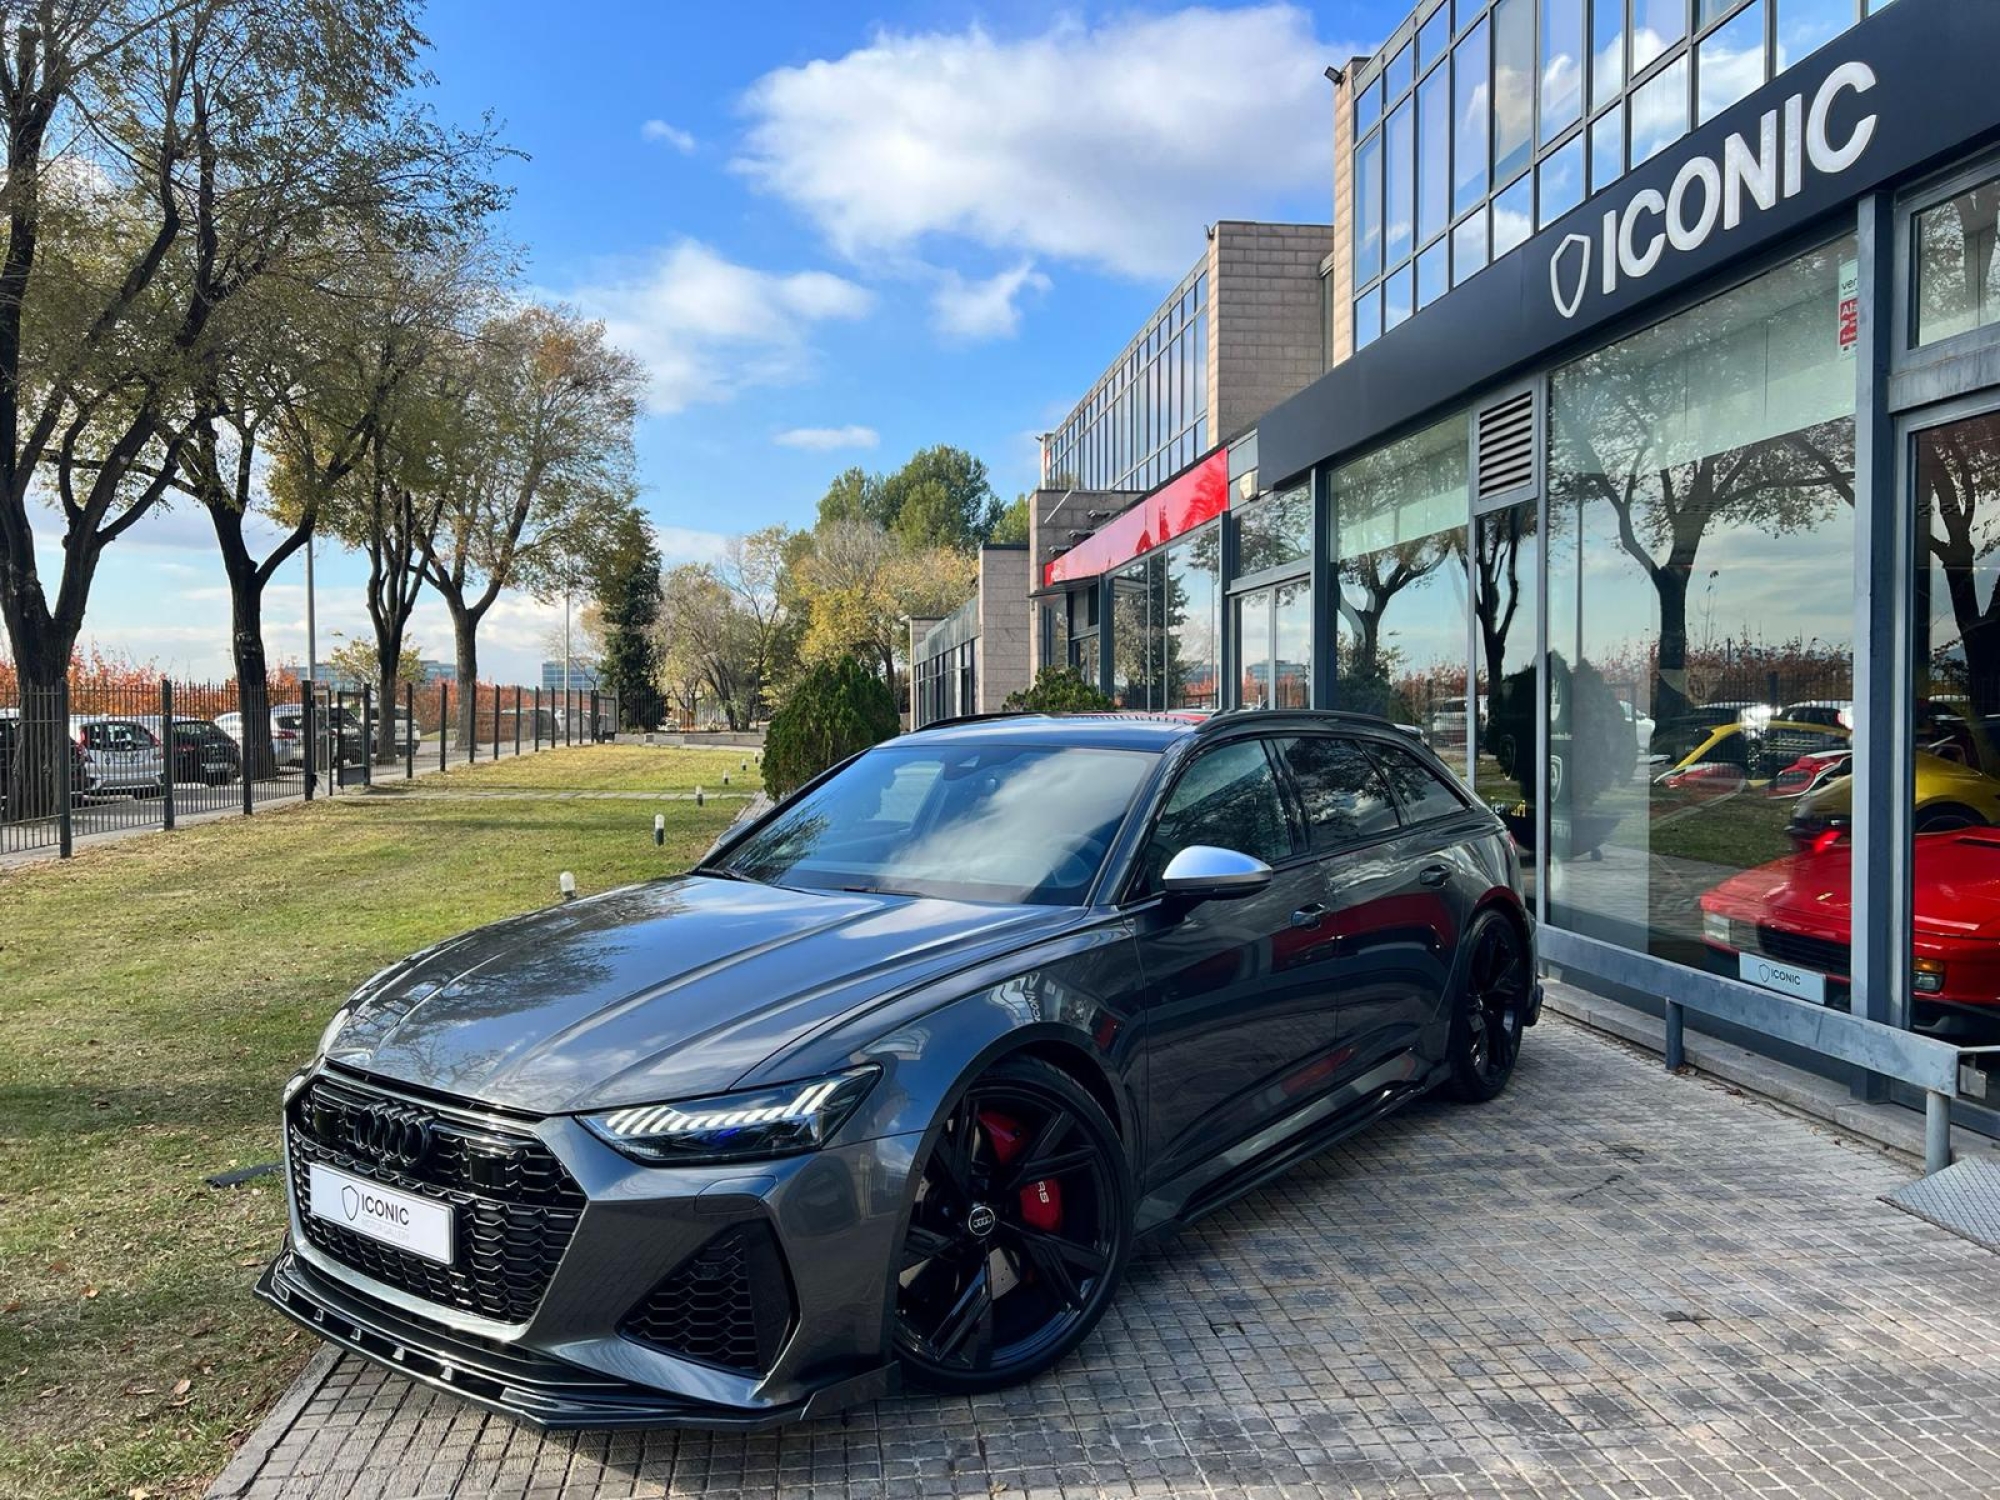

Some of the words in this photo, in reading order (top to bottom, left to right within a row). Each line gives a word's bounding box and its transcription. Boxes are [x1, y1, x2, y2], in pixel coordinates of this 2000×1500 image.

[1602, 61, 1877, 295] ICONIC
[1770, 969, 1801, 986] ICONIC
[361, 1194, 410, 1226] ICONIC
